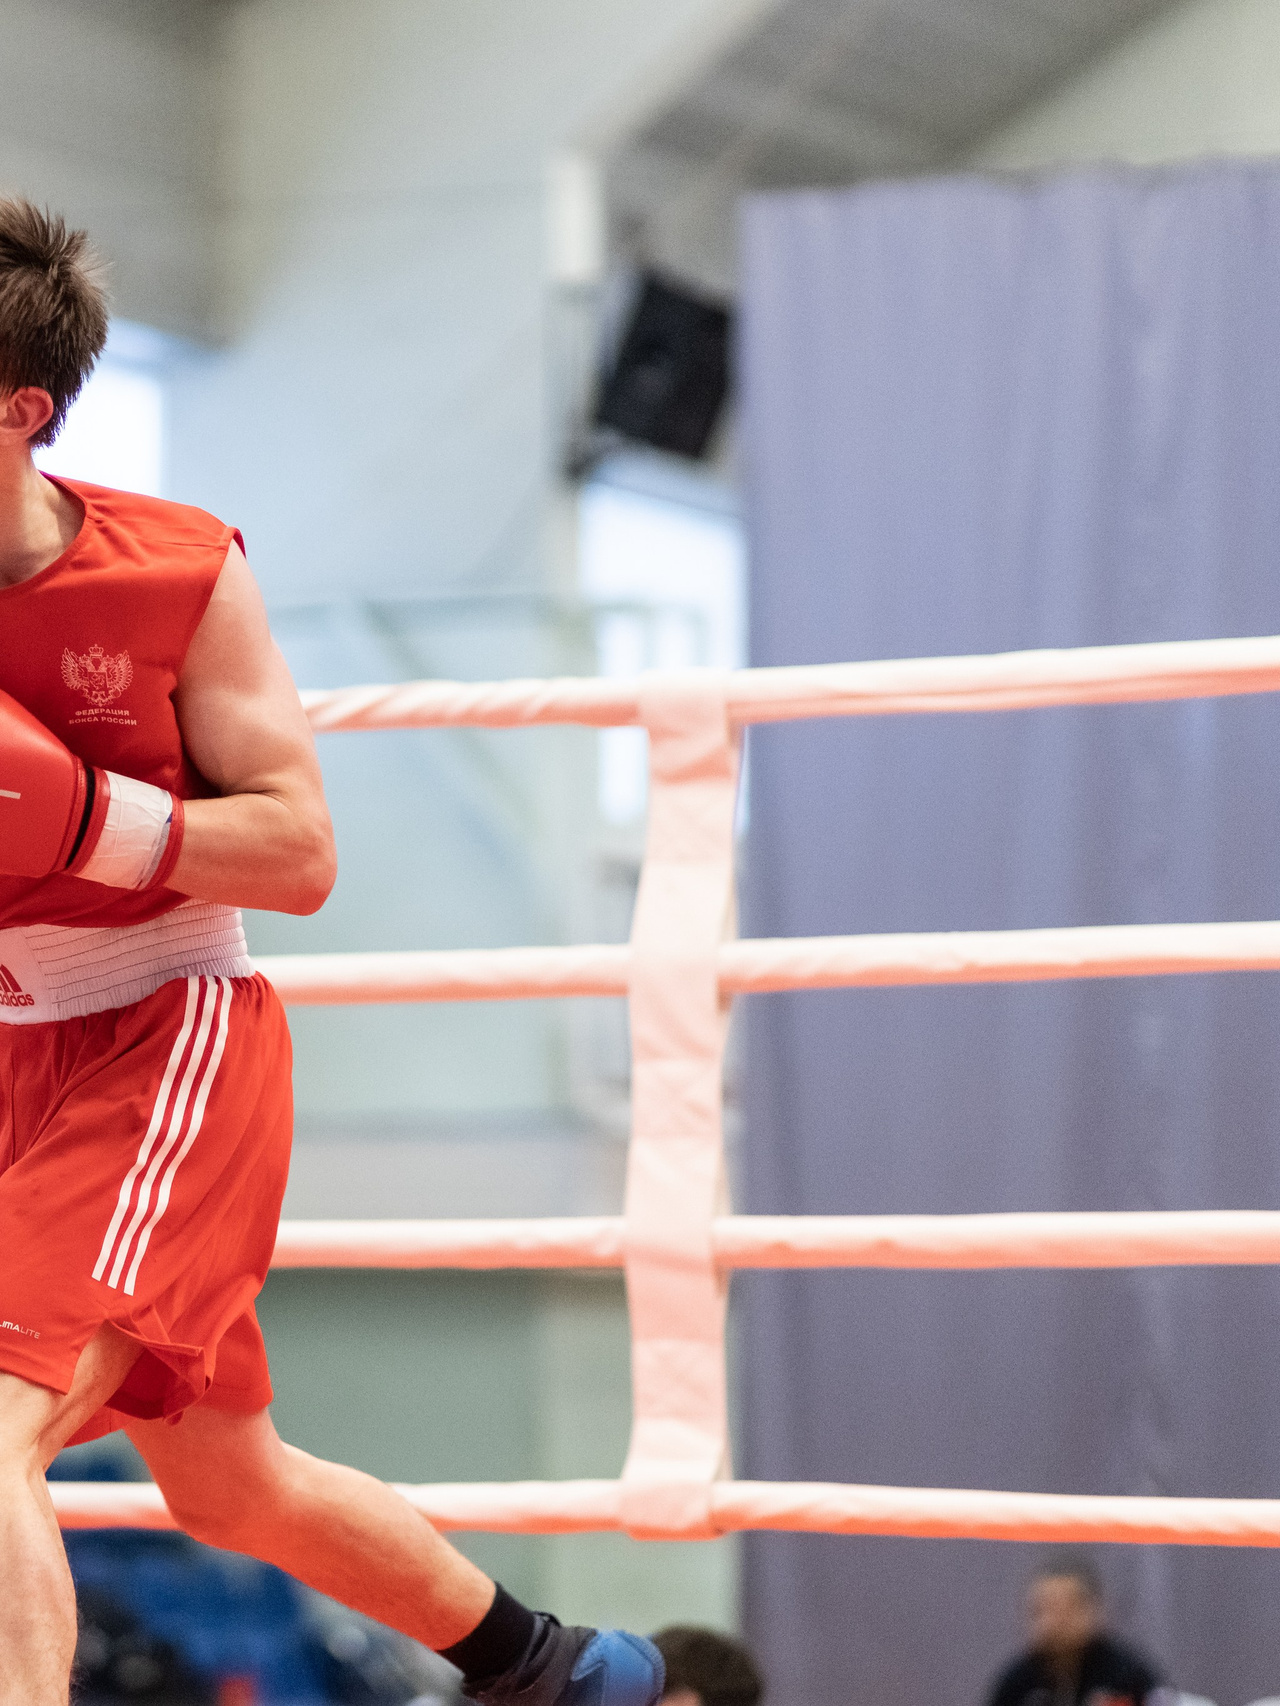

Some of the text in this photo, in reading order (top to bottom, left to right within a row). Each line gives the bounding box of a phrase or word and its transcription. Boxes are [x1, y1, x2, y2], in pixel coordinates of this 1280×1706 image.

[74, 708, 130, 717] ФЕДЕРАЦИЯ
[68, 716, 138, 726] БОКСА РОССИИ
